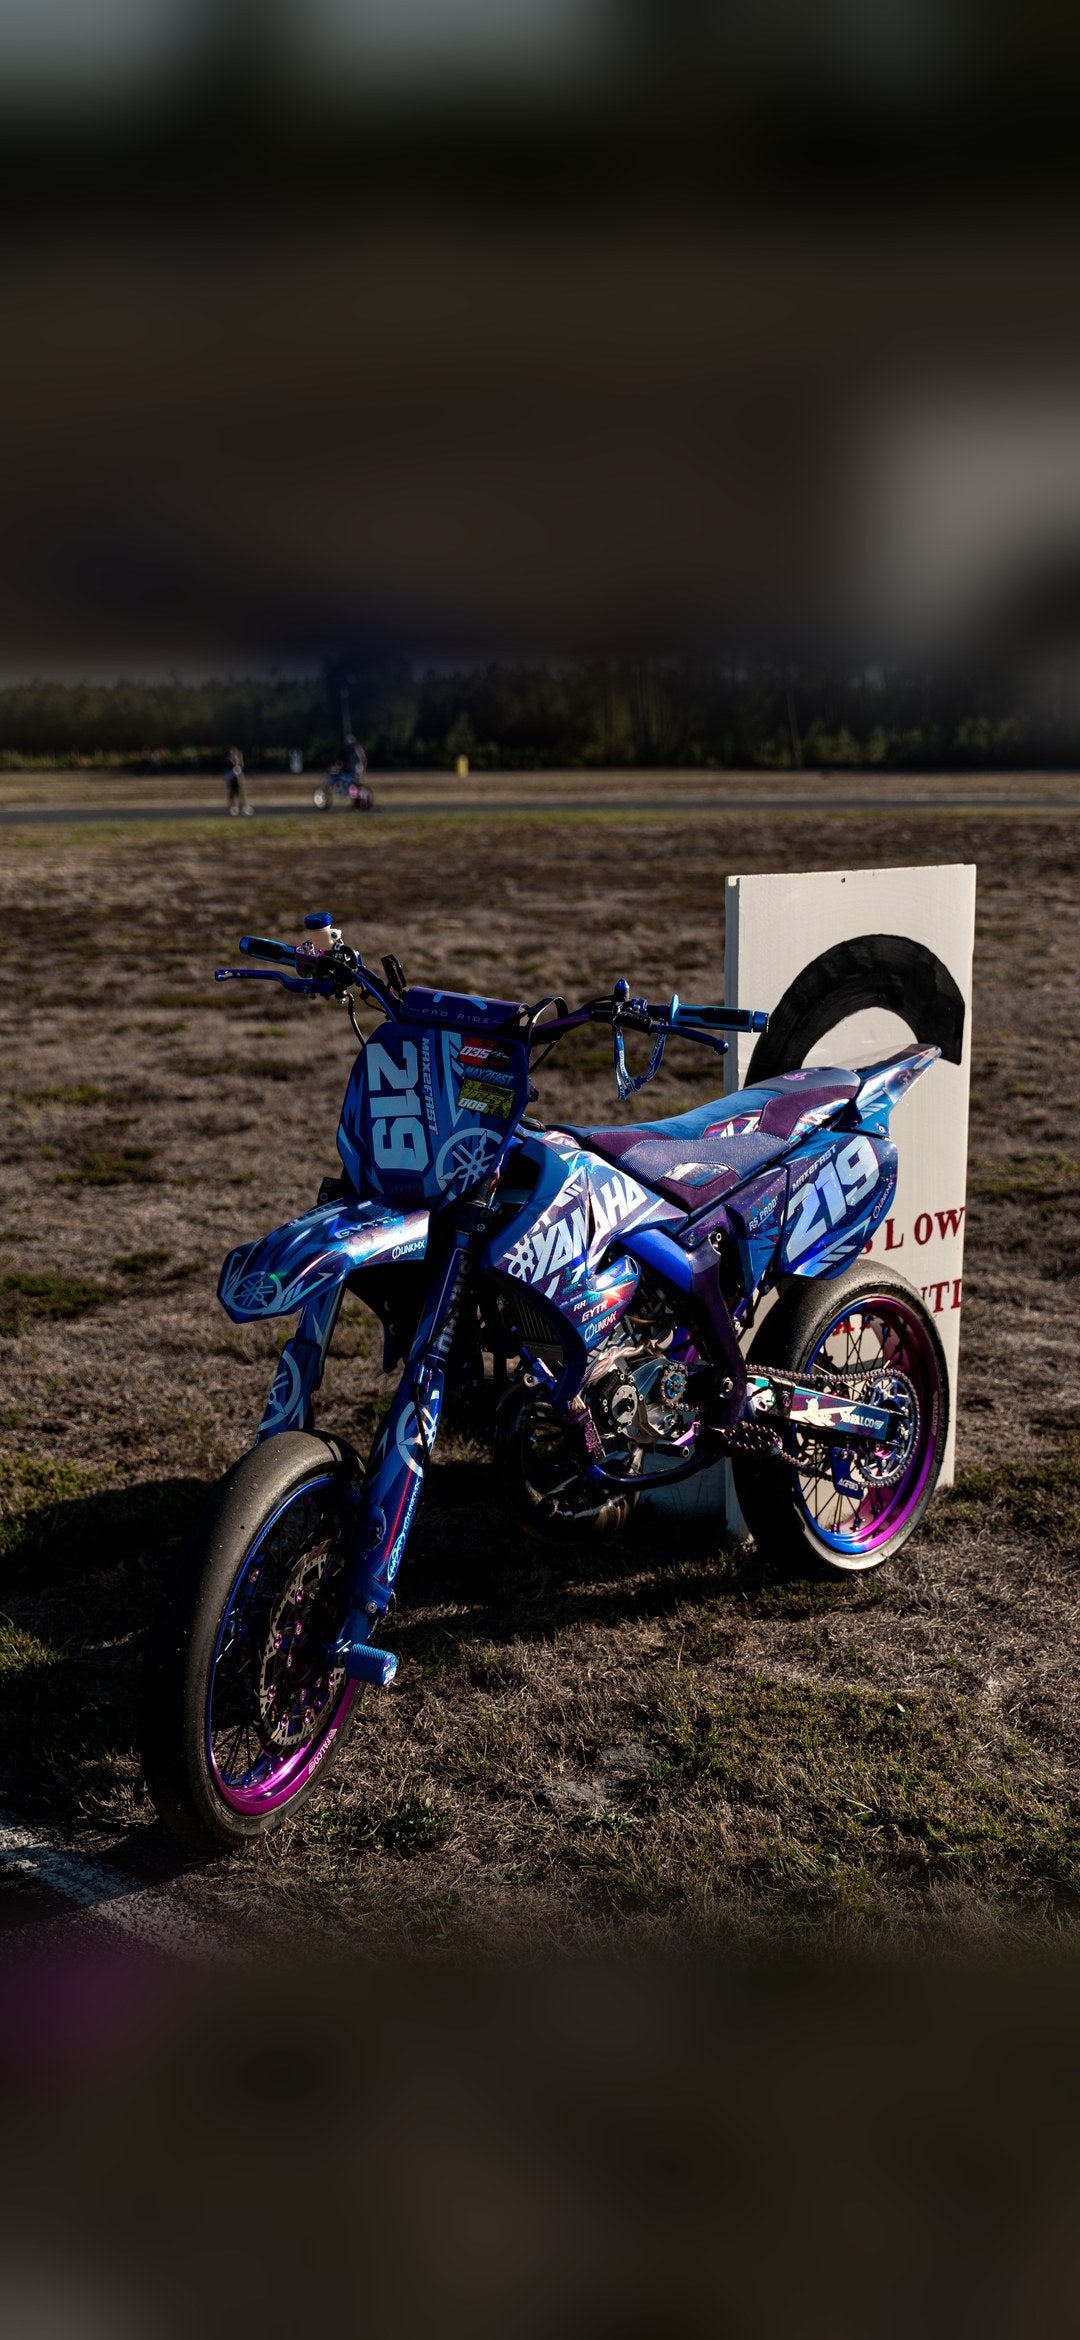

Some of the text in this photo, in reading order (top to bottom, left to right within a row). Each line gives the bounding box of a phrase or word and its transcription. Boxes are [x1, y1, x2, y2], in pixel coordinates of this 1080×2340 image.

[422, 1008, 491, 1024] PRO RIDE
[464, 1065, 515, 1087] MAX2FAST
[366, 1041, 429, 1171] 219
[785, 1135, 880, 1263] 219
[581, 1299, 609, 1323] GYTR
